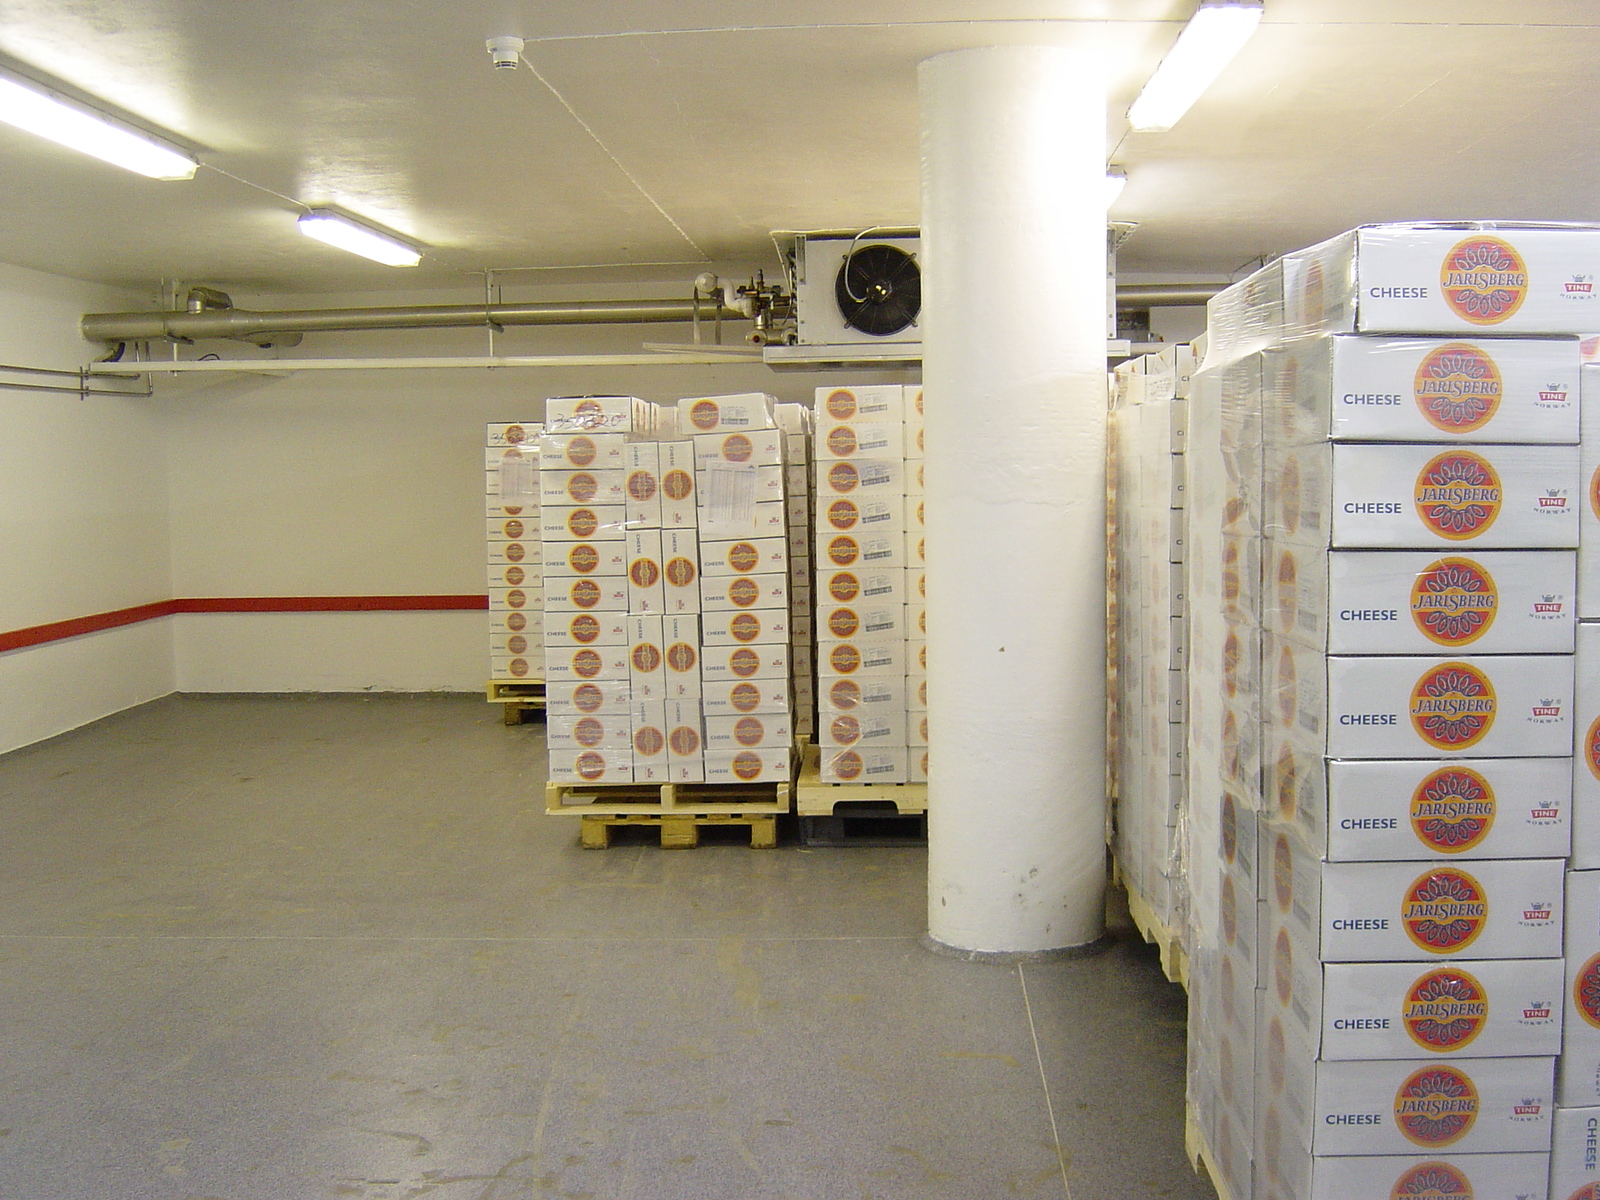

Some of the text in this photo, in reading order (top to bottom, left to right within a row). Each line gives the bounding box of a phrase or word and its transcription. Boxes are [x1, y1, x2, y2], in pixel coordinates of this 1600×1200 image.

[1443, 272, 1525, 290] JARLSBERG
[1369, 287, 1428, 299] CHEESE
[1566, 284, 1591, 292] TINE
[1416, 380, 1499, 397] JARLSBERG
[1343, 393, 1401, 406] CHEESE
[1540, 392, 1565, 401] TINE
[1417, 487, 1499, 504] JARLSBERG
[1344, 502, 1402, 514] CHEESE
[1540, 499, 1564, 507] TINE
[1413, 593, 1494, 610] JARLSBERG
[1340, 610, 1397, 621] CHEESE
[1412, 698, 1493, 715] JARLSBERG
[1340, 714, 1397, 725] CHEESE
[1412, 802, 1493, 819] JARLSBERG
[1340, 818, 1398, 829] CHEESE
[1404, 903, 1486, 920] JARLSBERG
[1332, 919, 1389, 930] CHEESE
[1405, 1003, 1487, 1019] JARLSBERG
[1334, 1018, 1390, 1030] CHEESE
[1396, 1098, 1476, 1115] JARLSBERG
[1325, 1114, 1381, 1125] CHEESE
[1585, 1118, 1598, 1171] CHEESE
